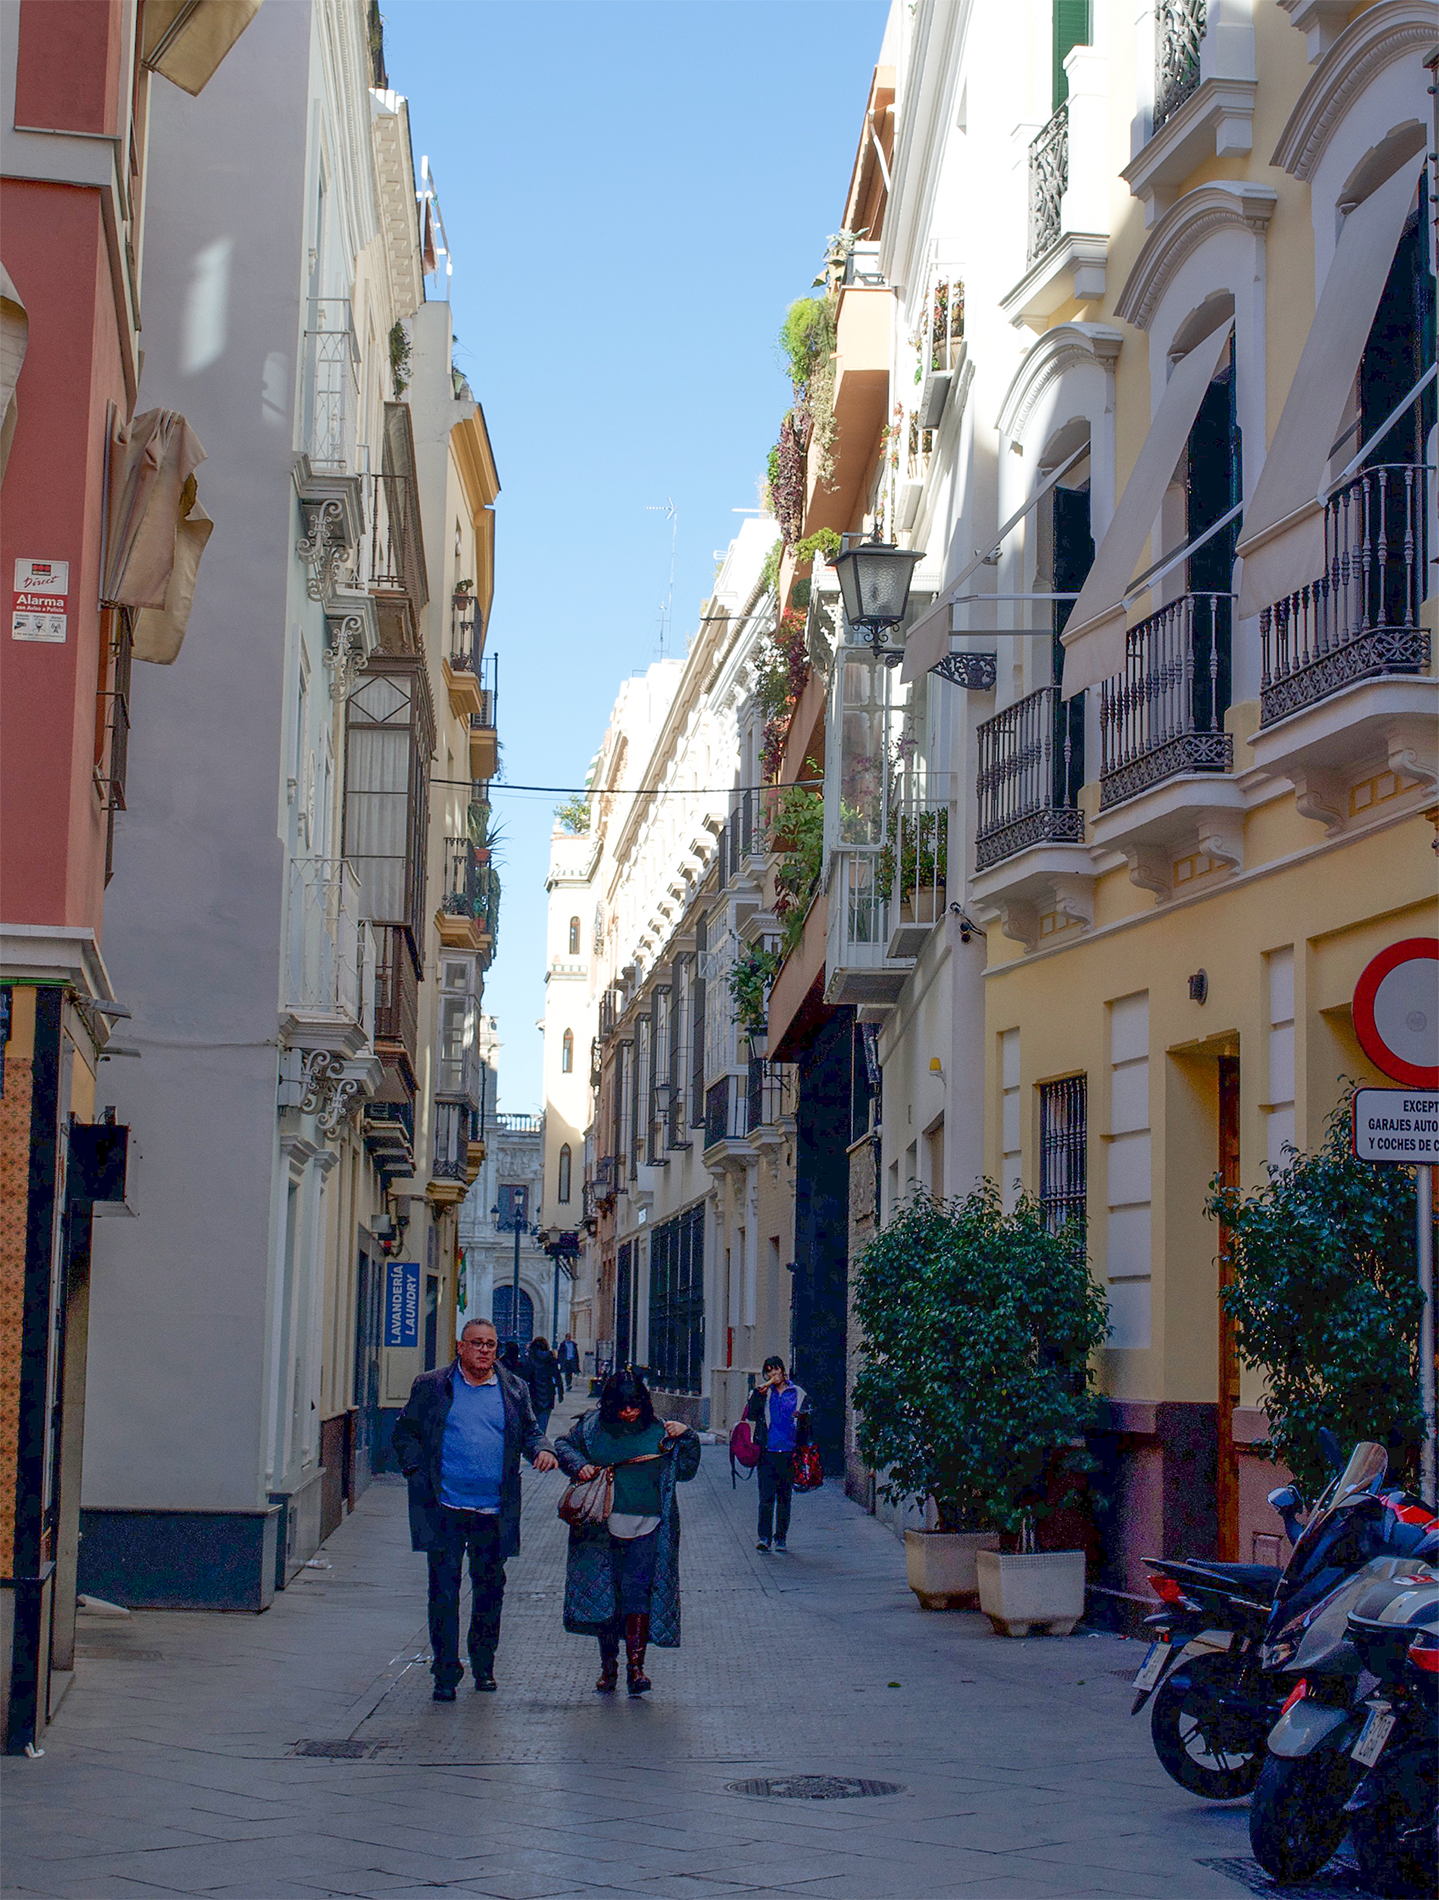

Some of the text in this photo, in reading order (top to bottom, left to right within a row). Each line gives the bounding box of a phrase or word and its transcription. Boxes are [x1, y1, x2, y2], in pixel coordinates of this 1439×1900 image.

[23, 576, 60, 588] Direct
[17, 594, 64, 607] Alarma
[1368, 1118, 1411, 1131] GARAJES
[1369, 1138, 1375, 1150] Y
[1377, 1138, 1416, 1151] COCHES
[1418, 1139, 1432, 1152] DE
[391, 1265, 403, 1344] LAVANDERÍA
[405, 1274, 416, 1335] LAUNDRY
